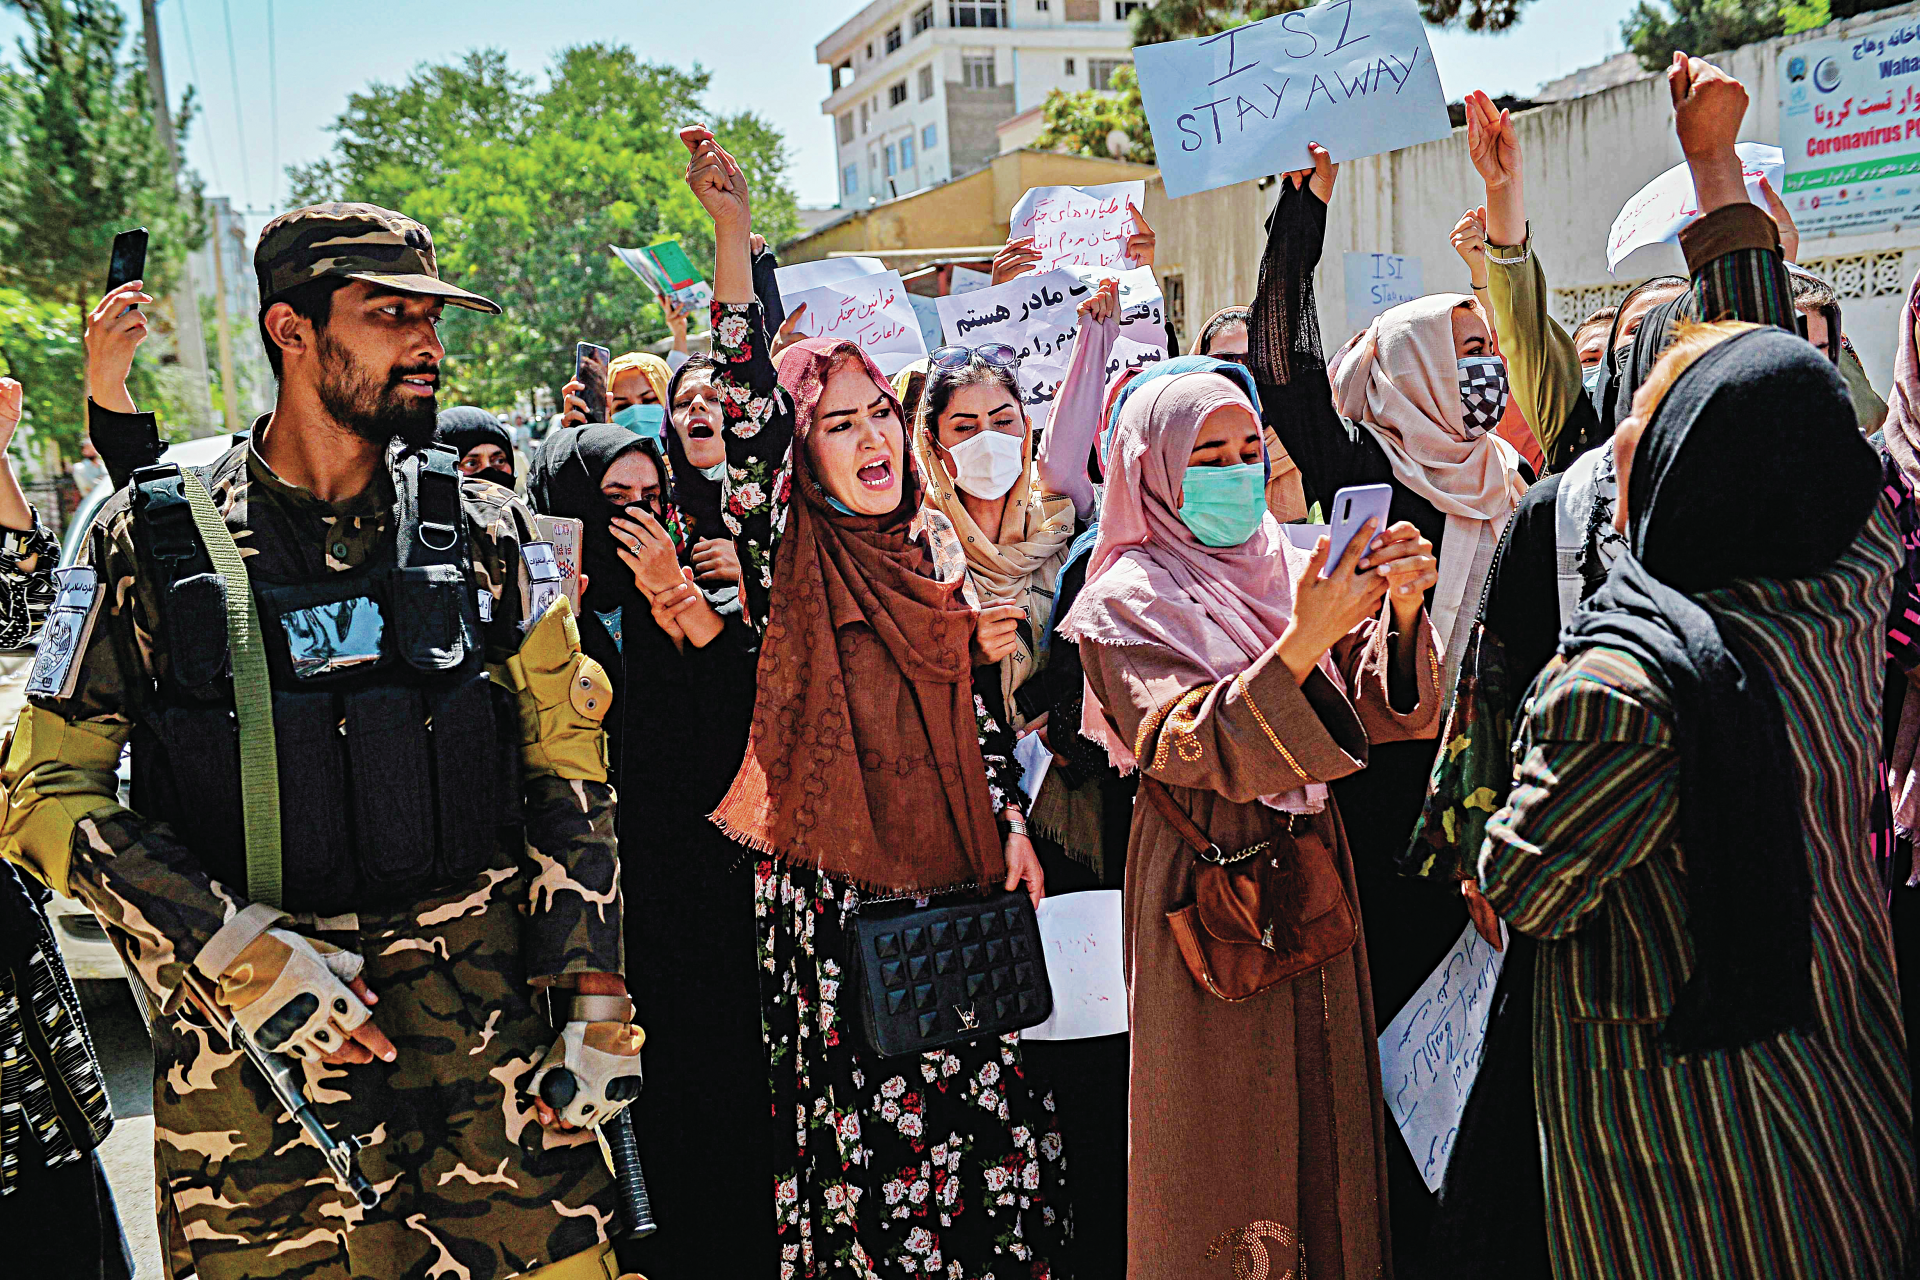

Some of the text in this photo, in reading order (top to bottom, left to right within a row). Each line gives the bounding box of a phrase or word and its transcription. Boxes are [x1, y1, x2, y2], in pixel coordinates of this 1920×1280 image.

[1177, 47, 1419, 152] STAY AWAY
[1857, 88, 1893, 115] تست
[1807, 125, 1902, 157] Coronavirus
[1371, 253, 1404, 280] ISI
[956, 304, 1011, 337] هستم
[1018, 286, 1065, 323] مادر
[1033, 336, 1052, 357] را
